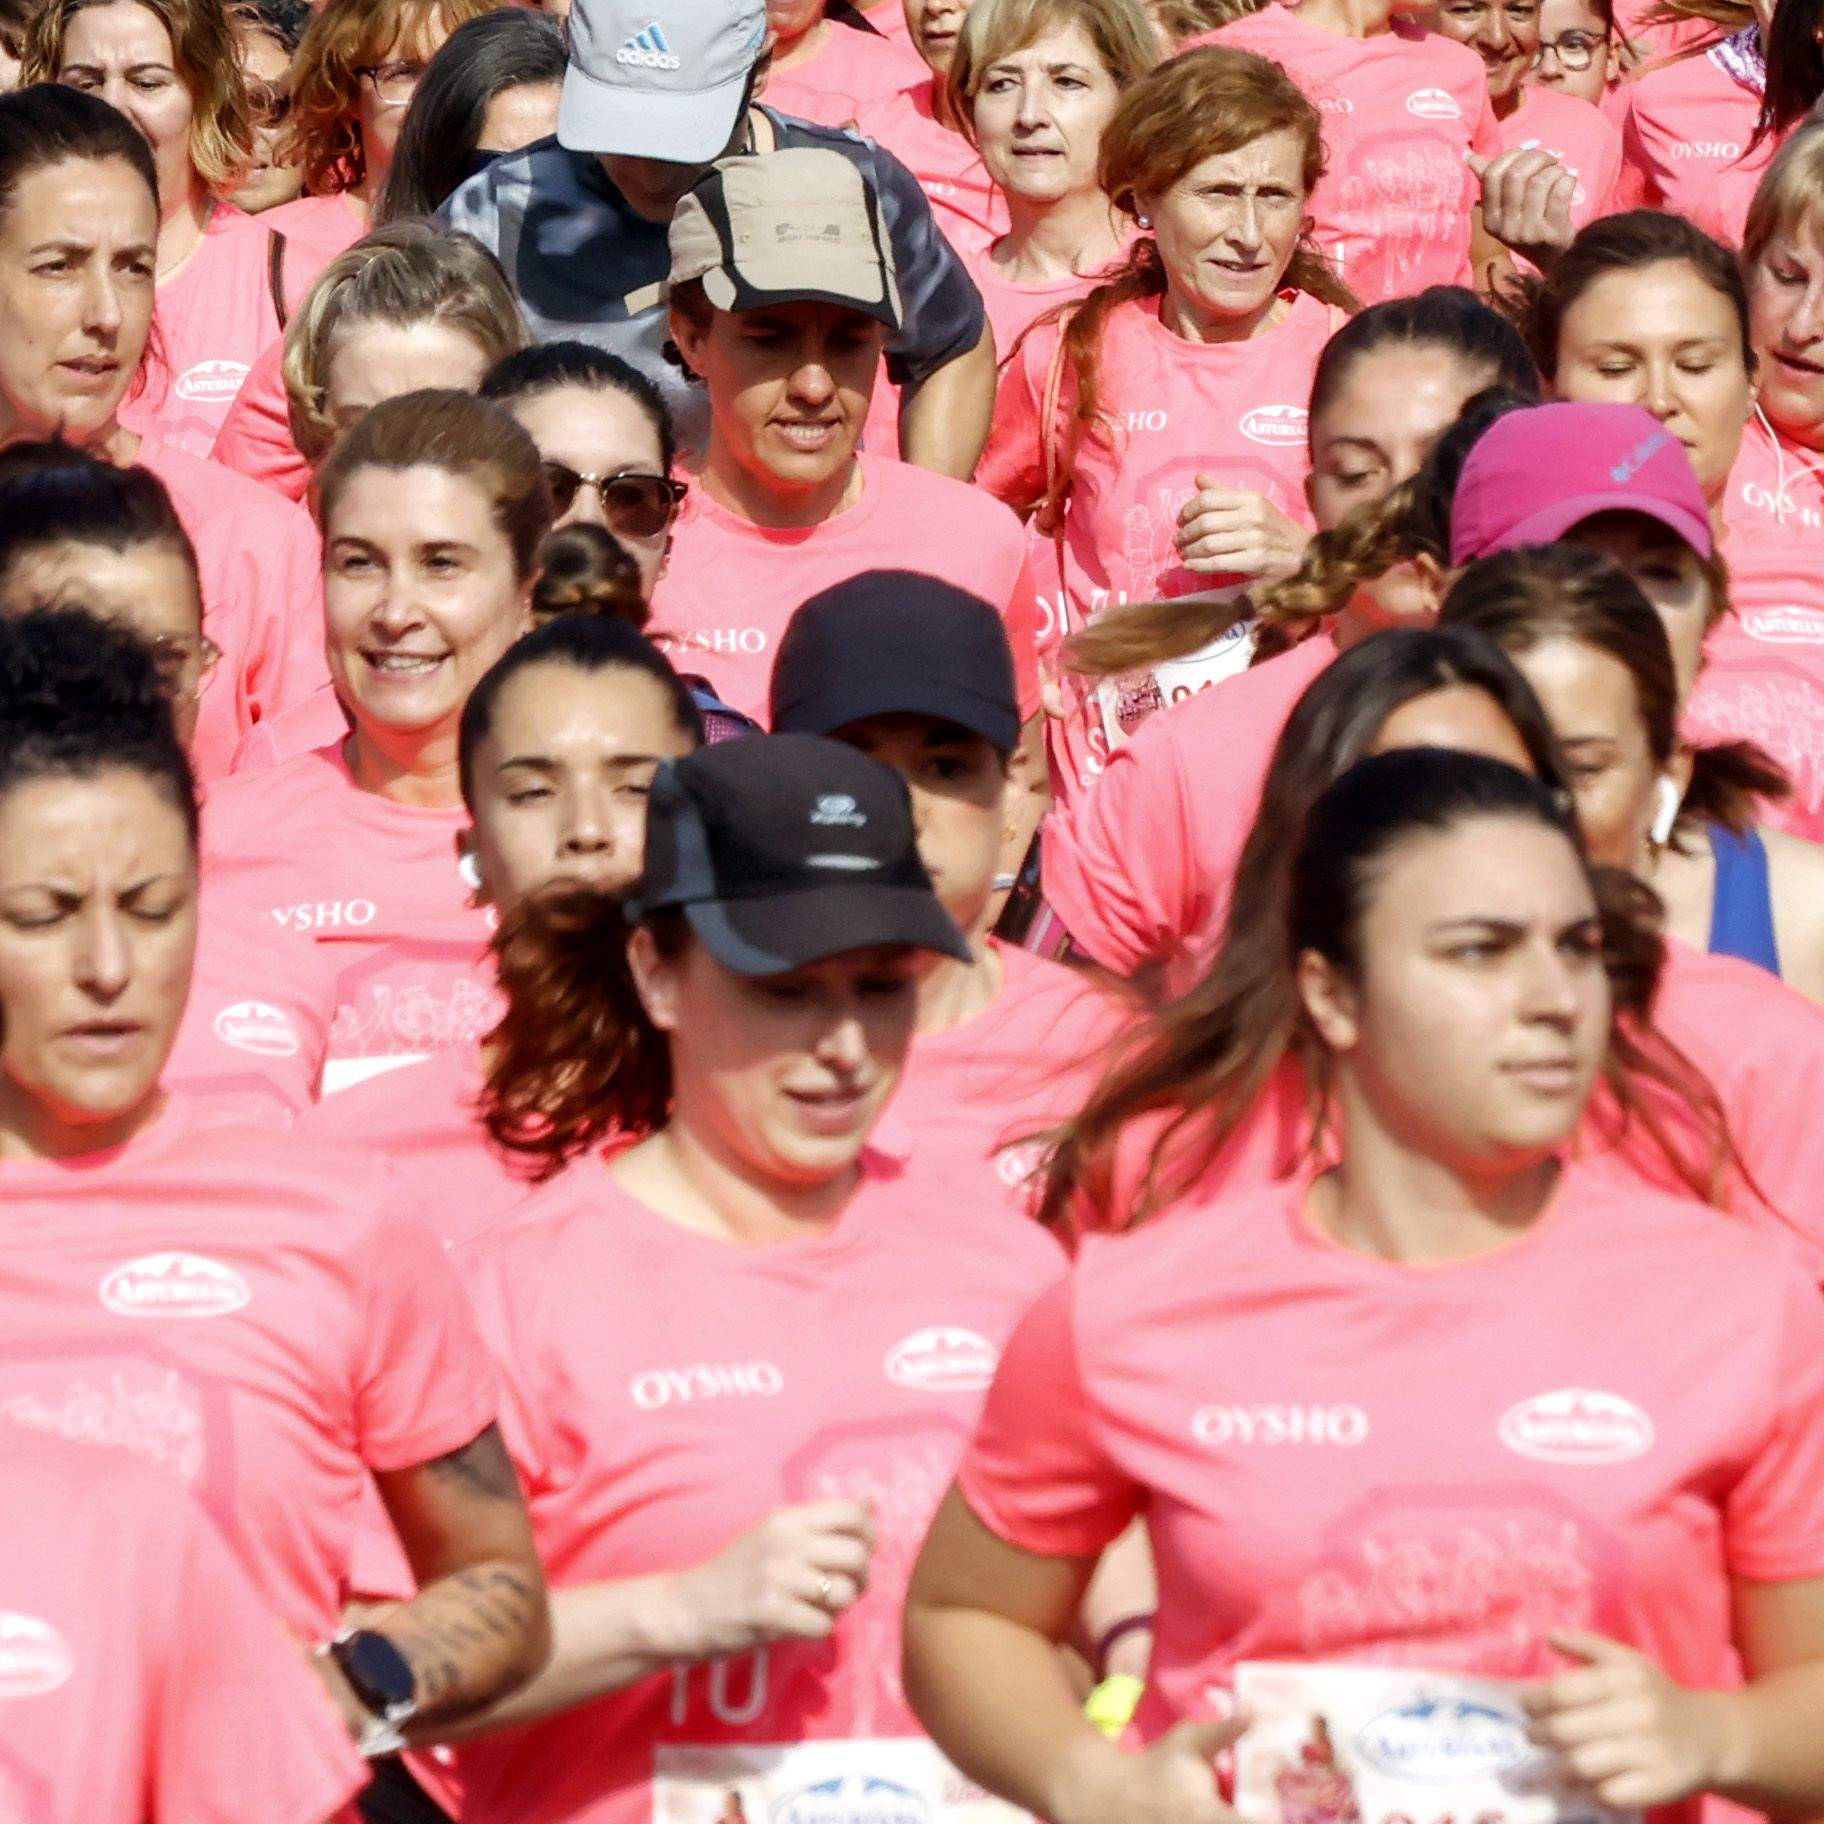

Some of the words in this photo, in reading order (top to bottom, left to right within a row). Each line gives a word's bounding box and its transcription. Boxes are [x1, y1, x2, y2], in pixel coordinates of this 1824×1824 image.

[616, 48, 681, 70] adidas
[1671, 140, 1740, 160] OYSHO
[632, 1359, 783, 1410] OYSHO
[1191, 1405, 1370, 1447] OYSHO
